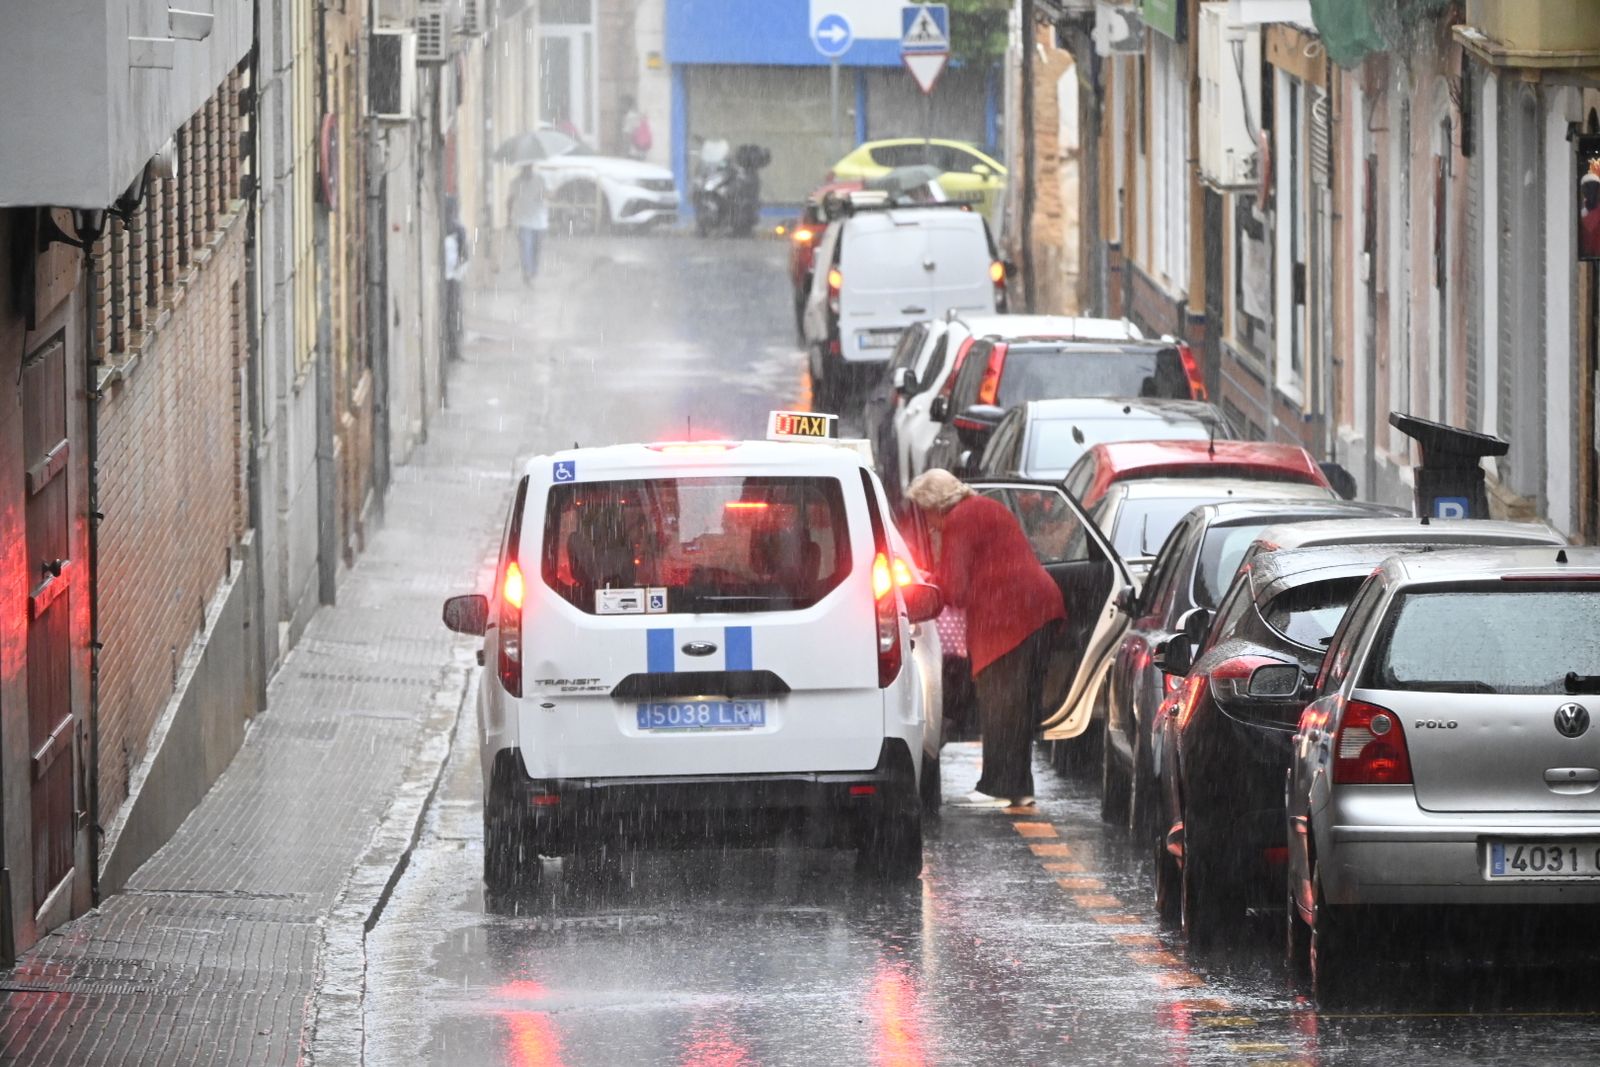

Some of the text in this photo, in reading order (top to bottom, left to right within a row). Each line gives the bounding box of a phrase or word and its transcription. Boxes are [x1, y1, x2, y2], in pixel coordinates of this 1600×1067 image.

[791, 415, 826, 436] TAXI
[1439, 502, 1464, 520] P
[534, 678, 601, 686] TRANSIT
[653, 704, 710, 724] 5038
[718, 703, 761, 723] LRM
[1415, 719, 1459, 729] POLO
[1511, 846, 1578, 872] 4031
